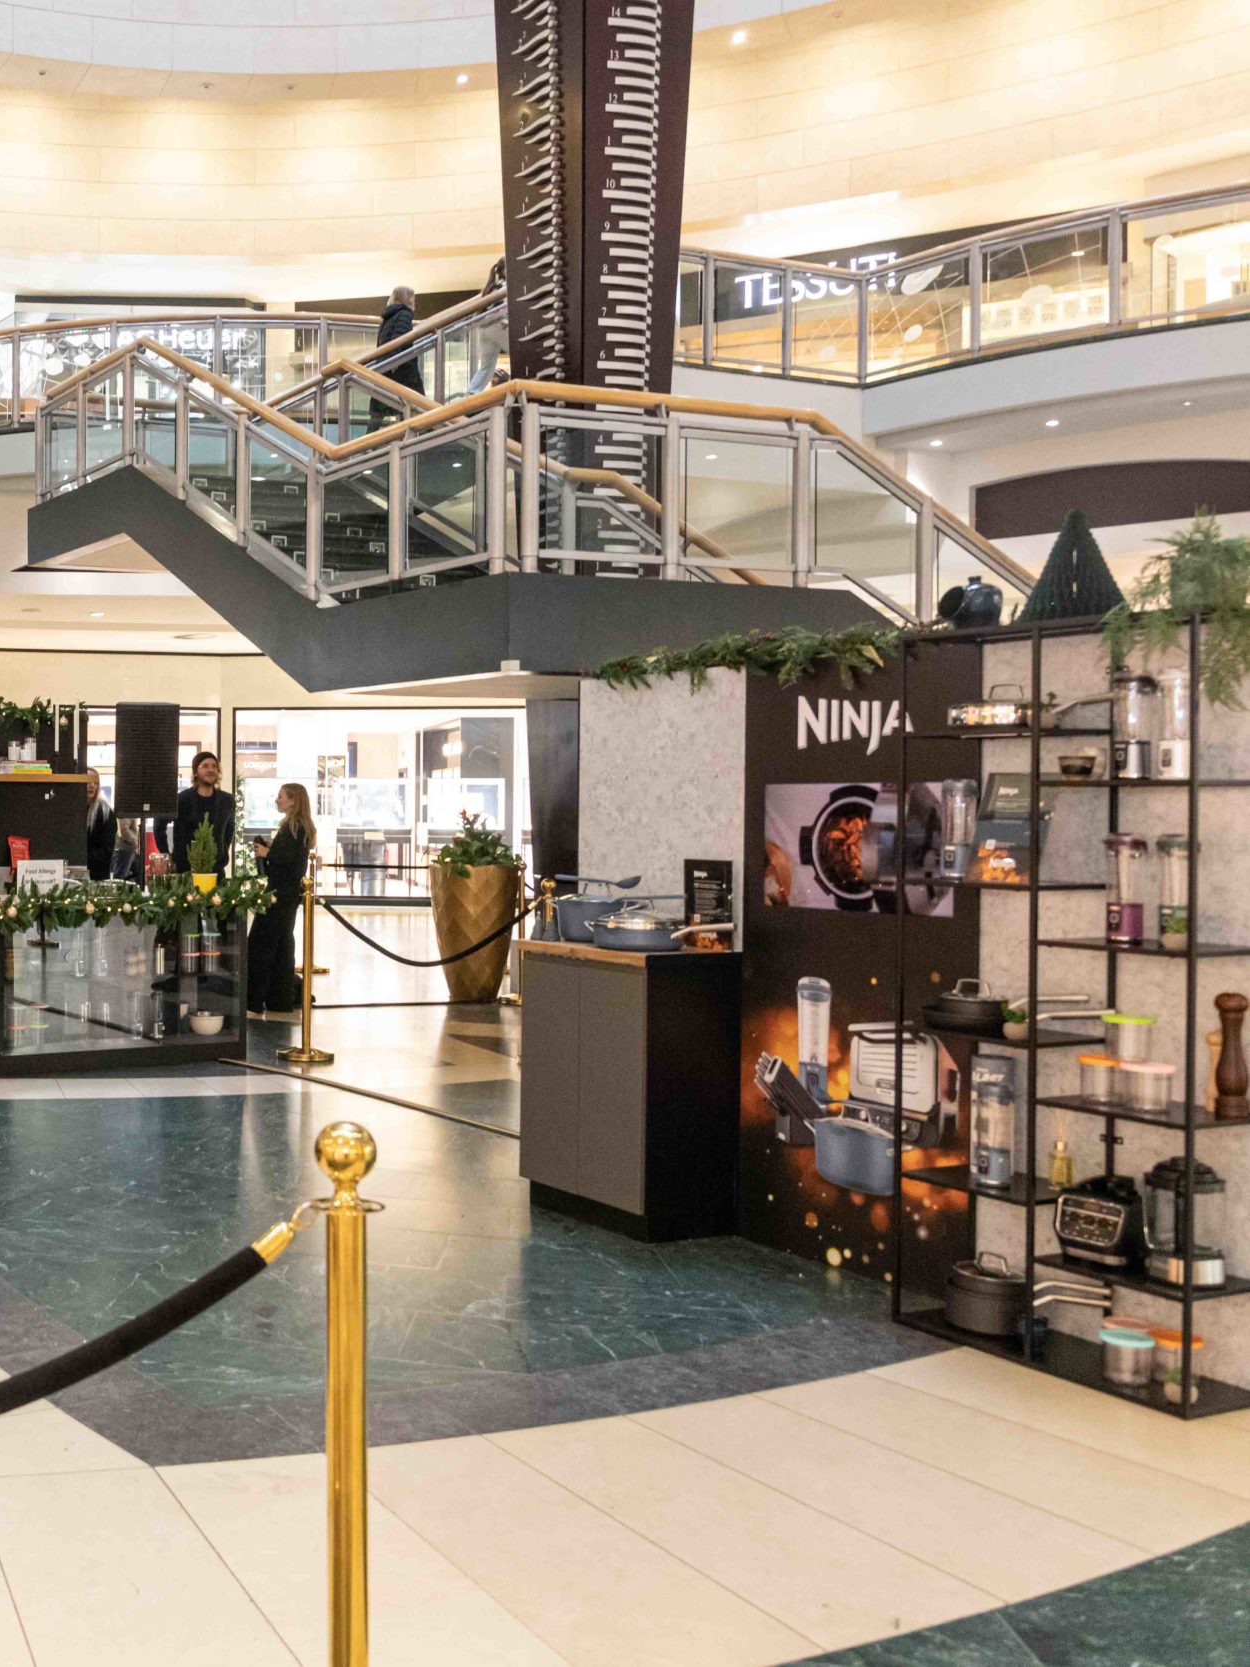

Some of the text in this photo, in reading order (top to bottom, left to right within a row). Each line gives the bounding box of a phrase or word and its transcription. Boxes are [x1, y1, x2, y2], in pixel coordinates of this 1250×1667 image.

[610, 48, 619, 60] 13
[608, 92, 618, 104] 12
[606, 178, 616, 190] 10
[604, 220, 610, 232] 9
[602, 264, 608, 274] 8
[602, 306, 607, 316] 7
[600, 350, 606, 360] 6
[797, 695, 915, 756] NINJA
